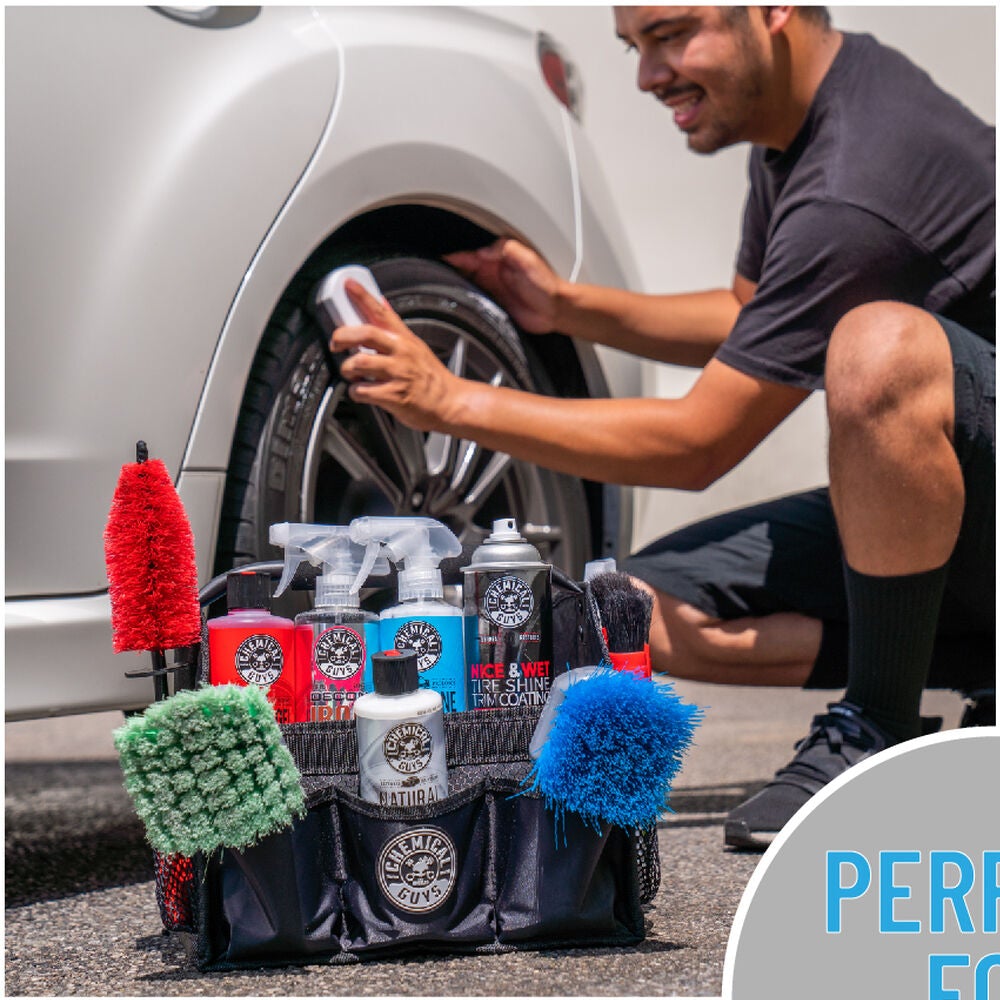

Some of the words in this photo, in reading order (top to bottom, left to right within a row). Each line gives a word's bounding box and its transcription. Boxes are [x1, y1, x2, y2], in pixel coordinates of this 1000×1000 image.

[491, 580, 530, 604] CHEMICAL
[496, 613, 523, 624] GUYS
[319, 633, 359, 658] CHEMICAL
[397, 624, 437, 649] CHEMICAL
[239, 639, 281, 662] CHEMICAL
[247, 671, 274, 683] GUYS
[325, 665, 353, 677] GUYS
[471, 664, 504, 678] NICE
[509, 663, 520, 677] &
[521, 661, 550, 677] WET
[471, 679, 500, 693] TIRE
[506, 677, 550, 692] SHINE
[472, 694, 496, 706] TRIM
[387, 726, 431, 751] CHEMICAL
[398, 759, 423, 772] GUYS
[385, 835, 450, 872] CHEMICAL
[398, 885, 441, 904] GUYS
